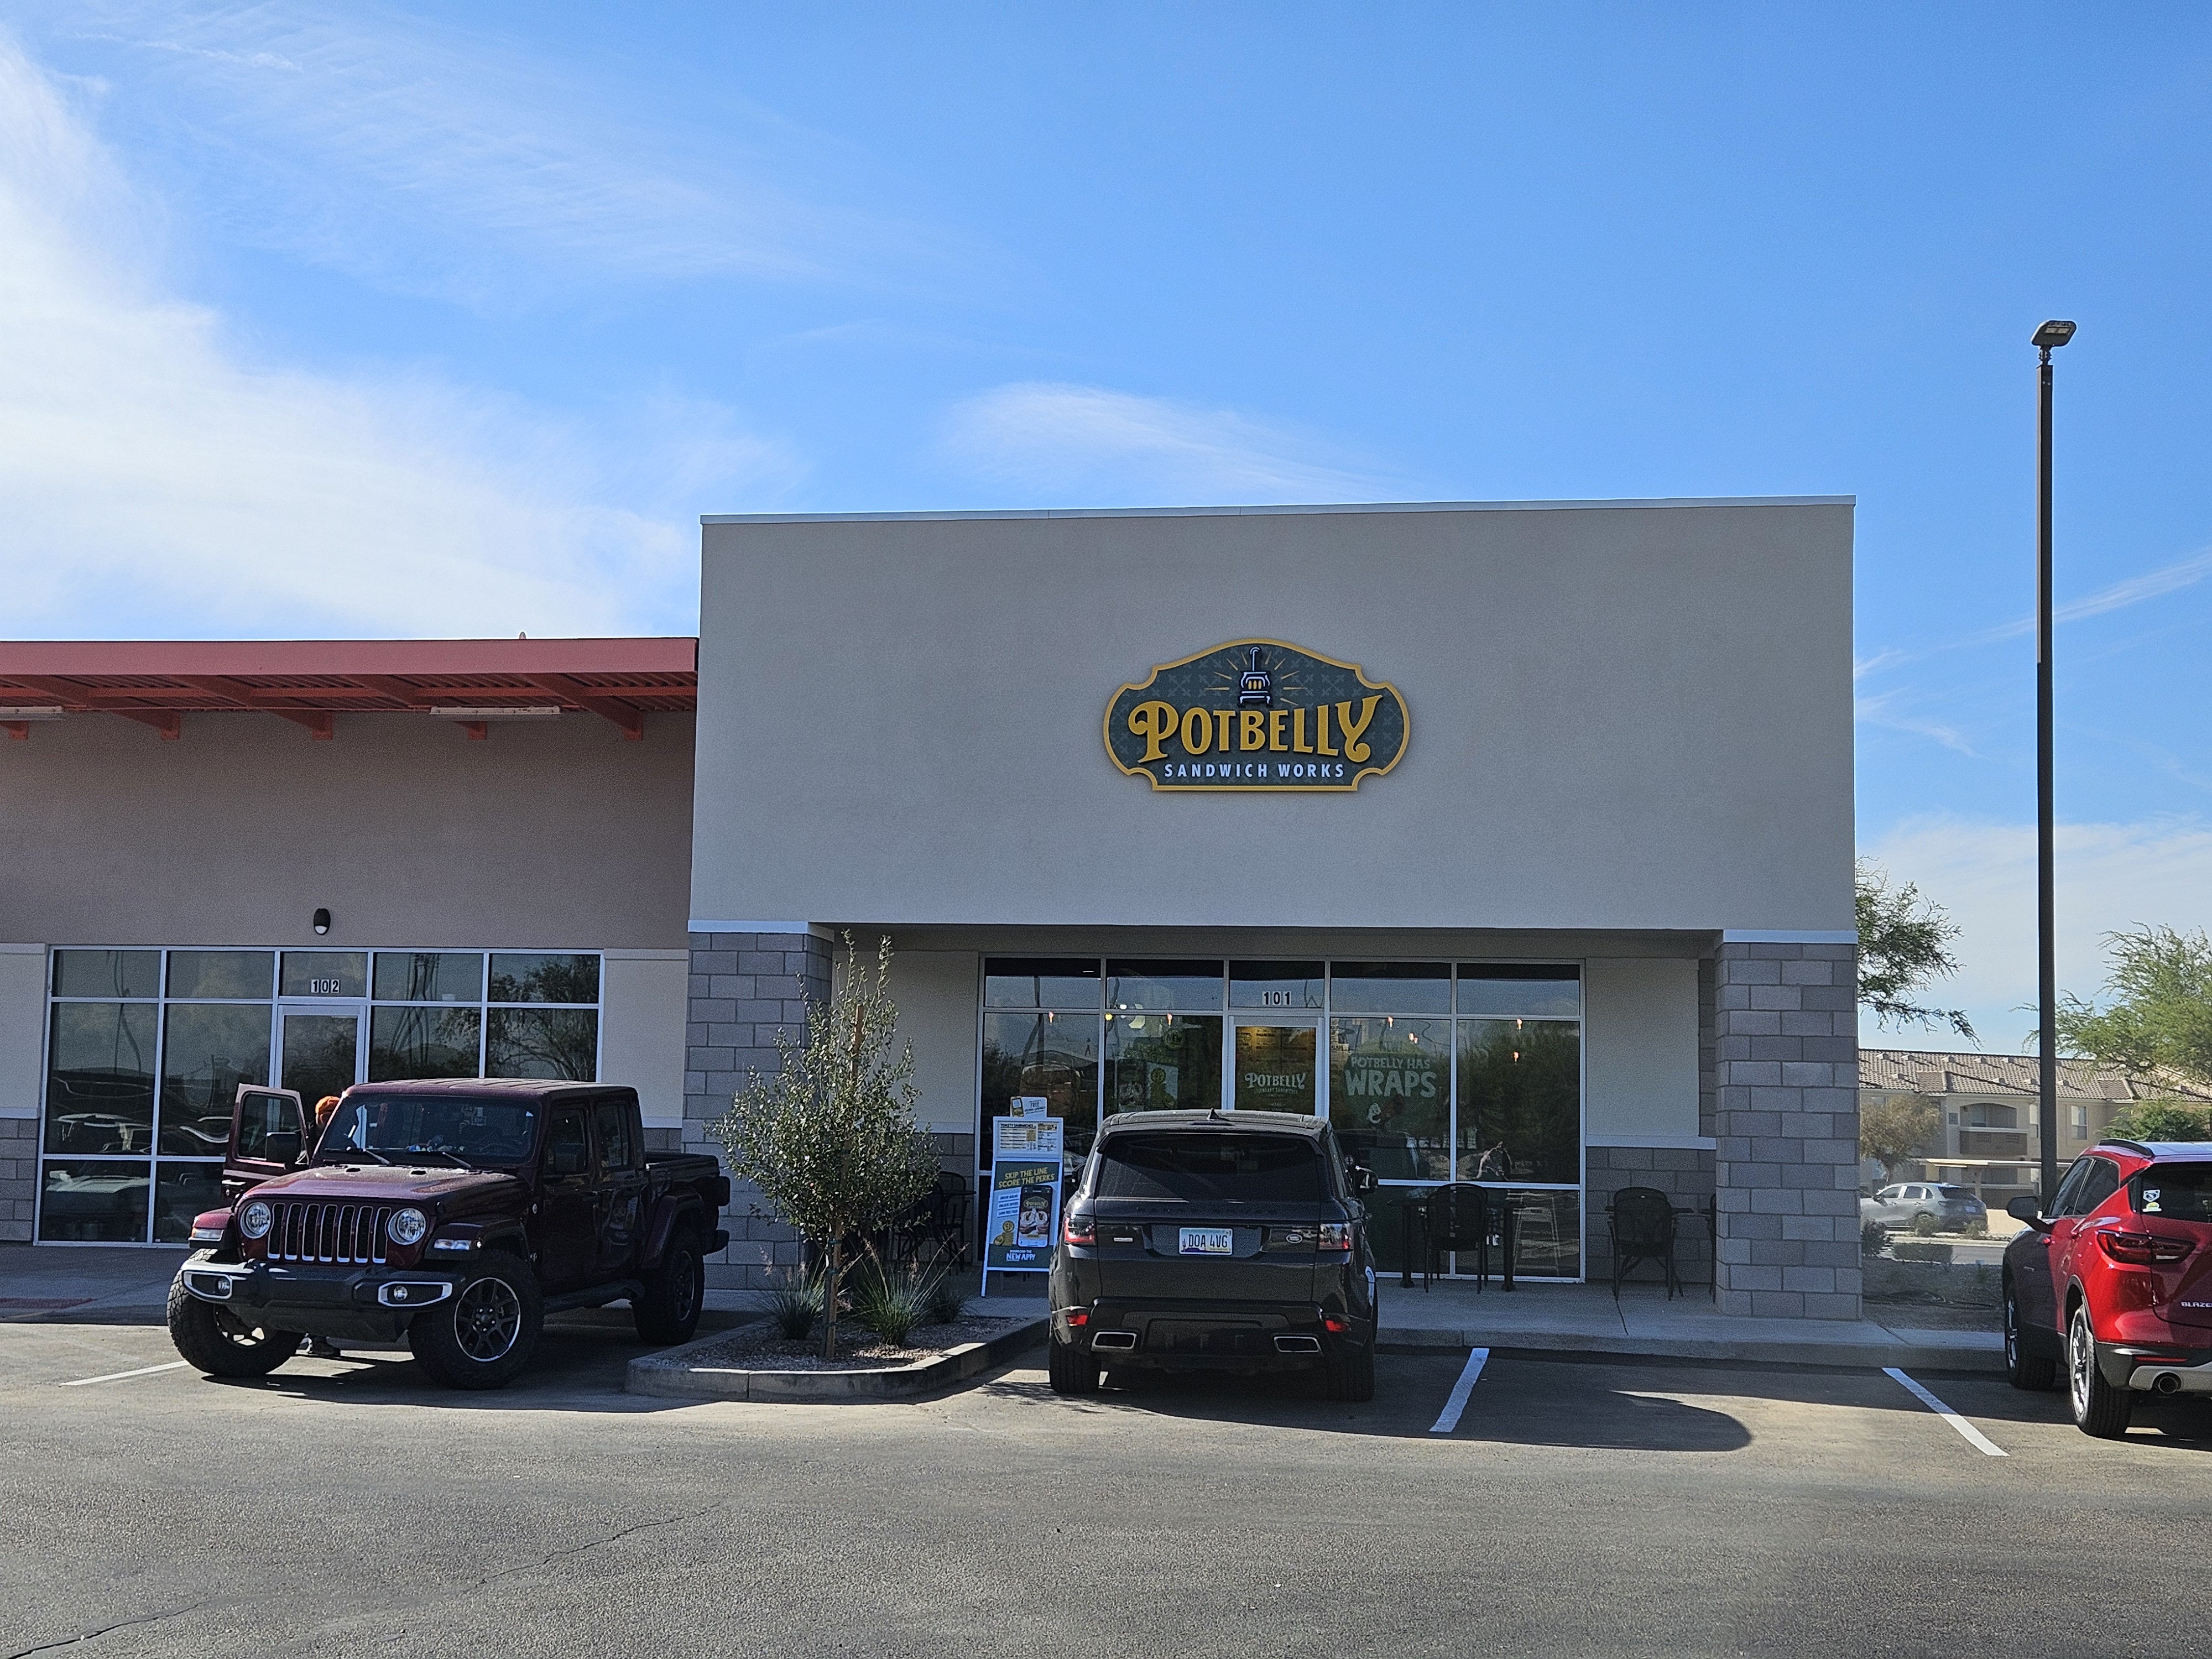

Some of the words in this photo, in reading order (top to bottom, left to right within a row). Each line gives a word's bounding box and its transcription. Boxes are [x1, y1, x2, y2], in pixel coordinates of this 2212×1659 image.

[1128, 695, 1383, 764] POTBELLY
[1164, 763, 1268, 778] SANDWICH
[1278, 764, 1344, 778] WORKS
[313, 980, 338, 992] 102
[1264, 992, 1290, 1005] 101
[1350, 1056, 1404, 1068] POTBELLY
[1407, 1057, 1431, 1069] HAS
[1244, 1072, 1307, 1089] POTBELLY
[1344, 1069, 1437, 1098] WRAPS
[998, 1178, 1020, 1188] SCORE
[1022, 1176, 1035, 1185] THE
[1036, 1173, 1055, 1182] PERKS
[1005, 1171, 1019, 1180] SKIP
[1020, 1169, 1033, 1177] THE
[1034, 1167, 1048, 1175] LINE
[1188, 1234, 1207, 1248] DOA
[1209, 1234, 1228, 1248] 4VG
